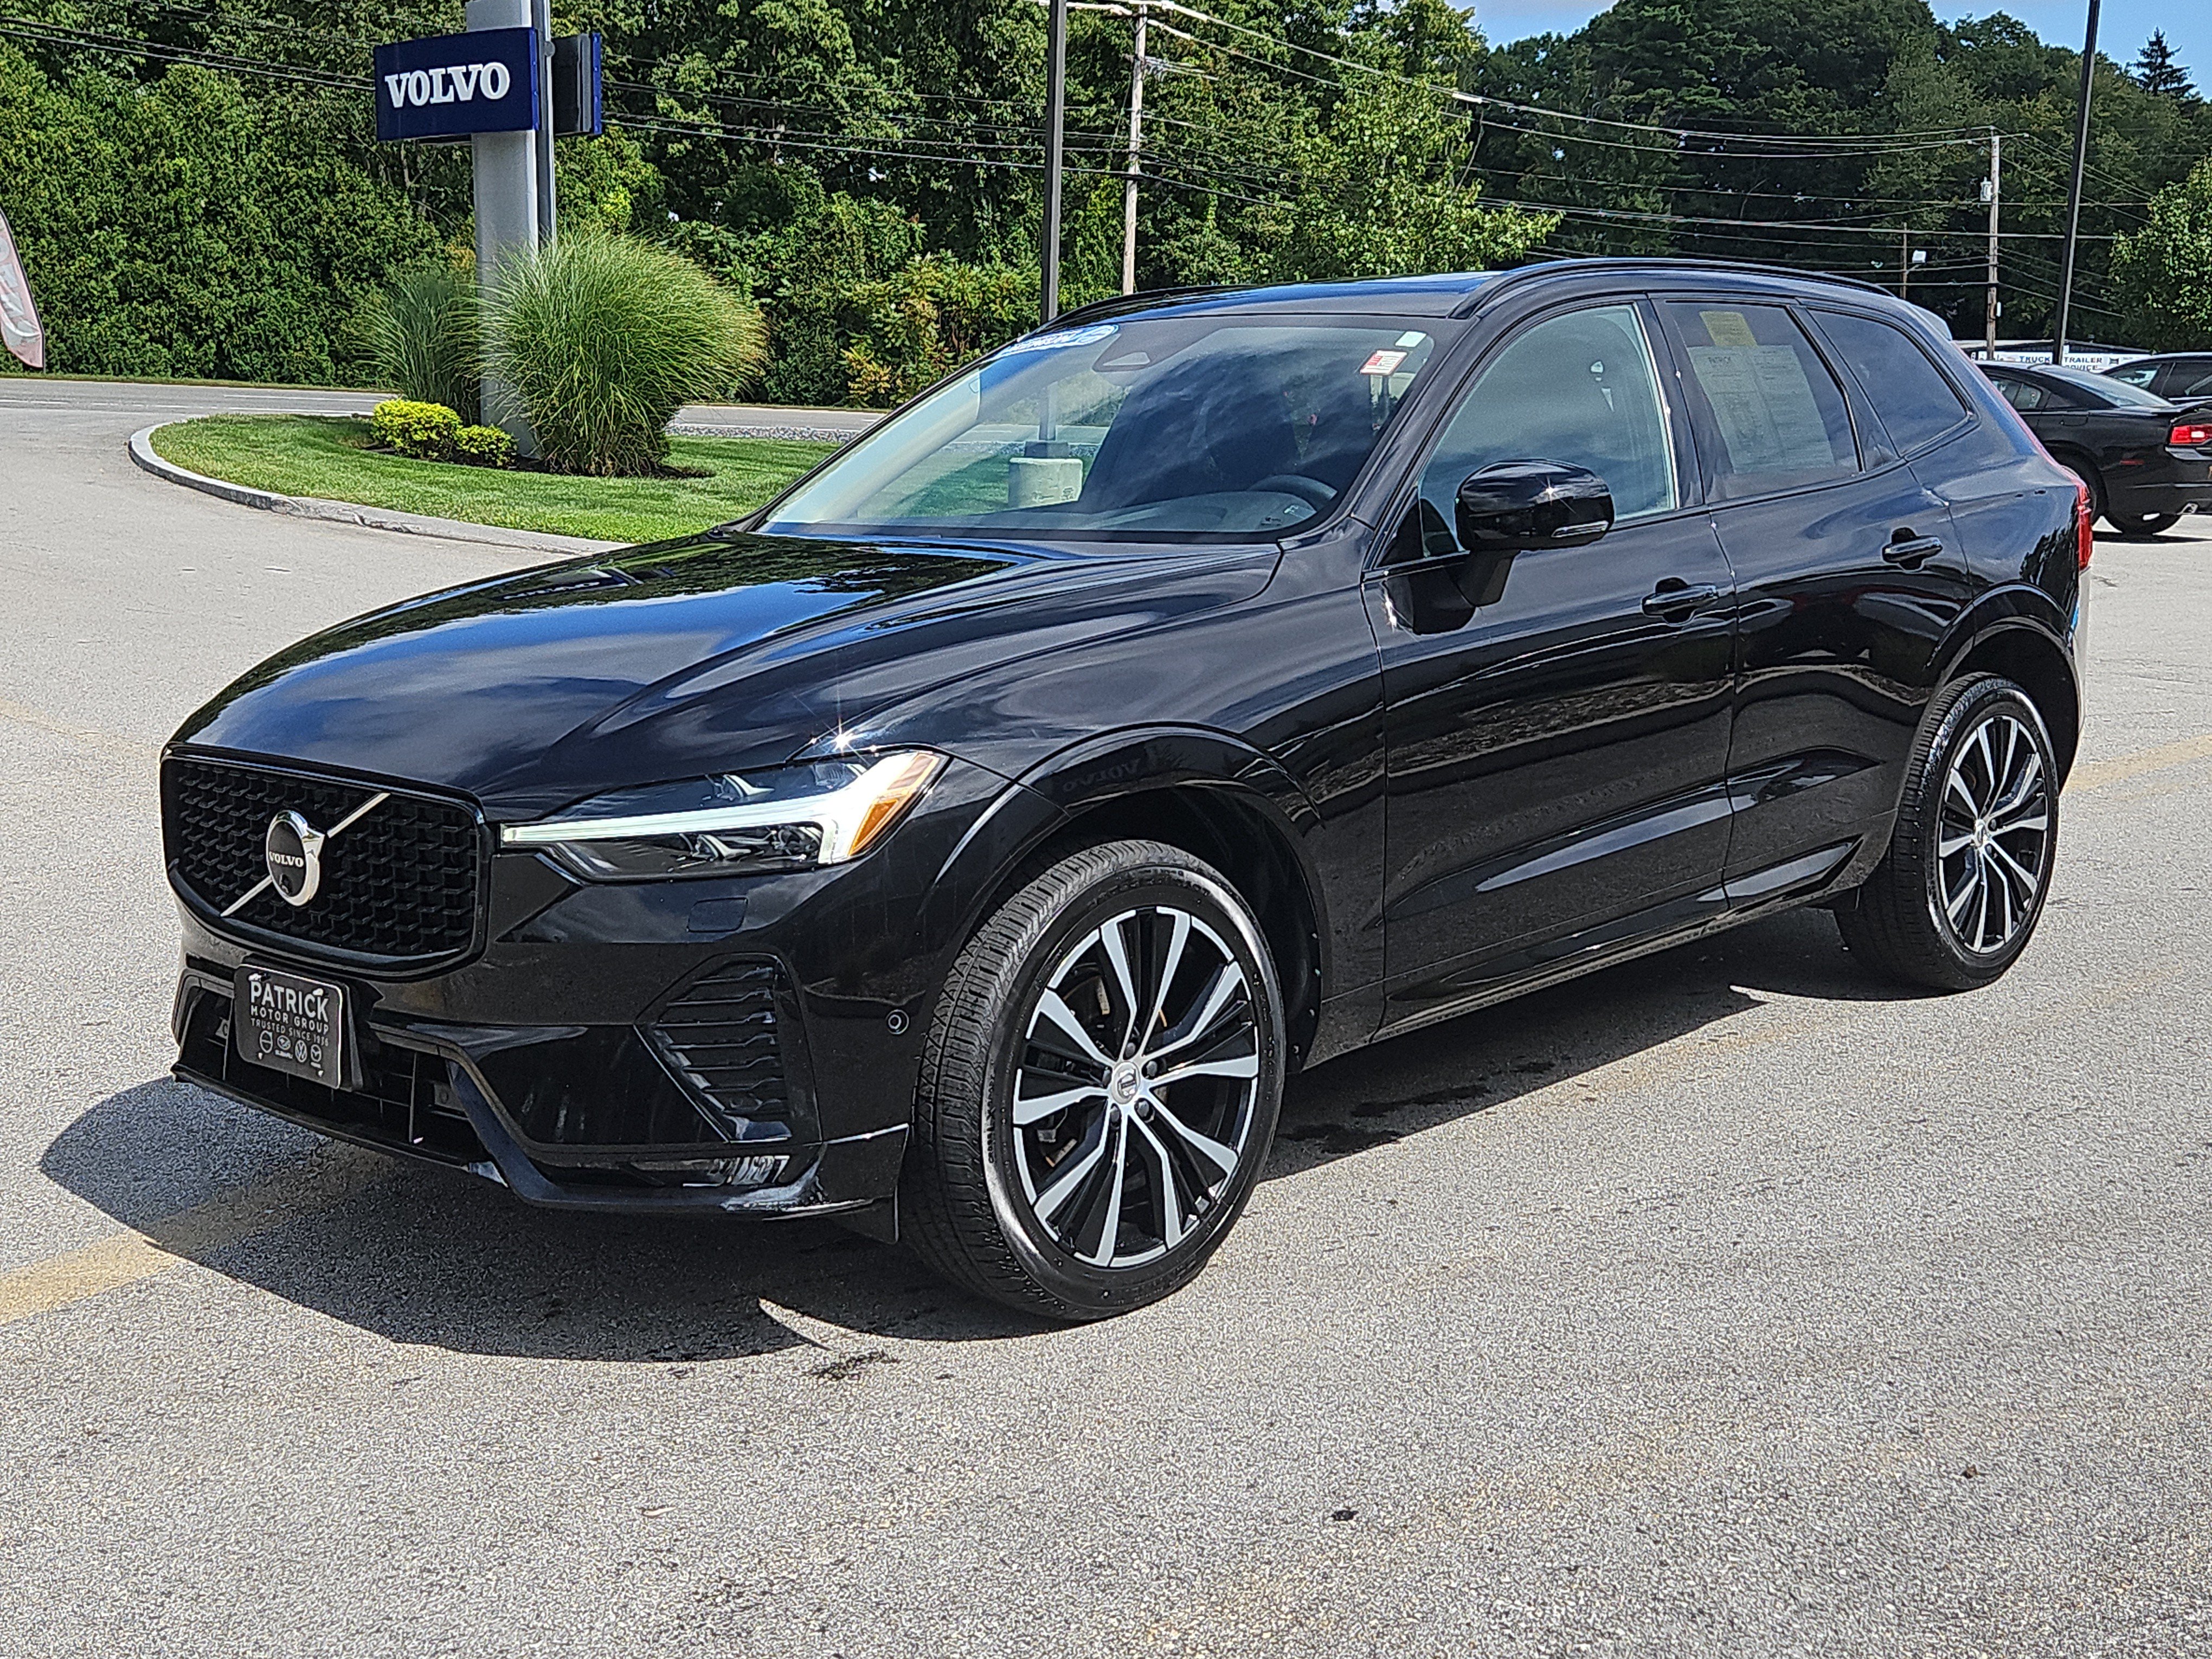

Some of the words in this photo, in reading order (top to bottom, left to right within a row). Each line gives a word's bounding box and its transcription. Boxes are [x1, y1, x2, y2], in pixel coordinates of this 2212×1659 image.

[384, 61, 511, 108] VOLVO
[269, 851, 304, 867] VOLVO
[250, 981, 330, 1023] PATRICK
[250, 1005, 288, 1024] MOTOR
[293, 1017, 329, 1034] GROUP
[250, 1018, 286, 1034] TRUSTED
[288, 1027, 311, 1041] SINCE
